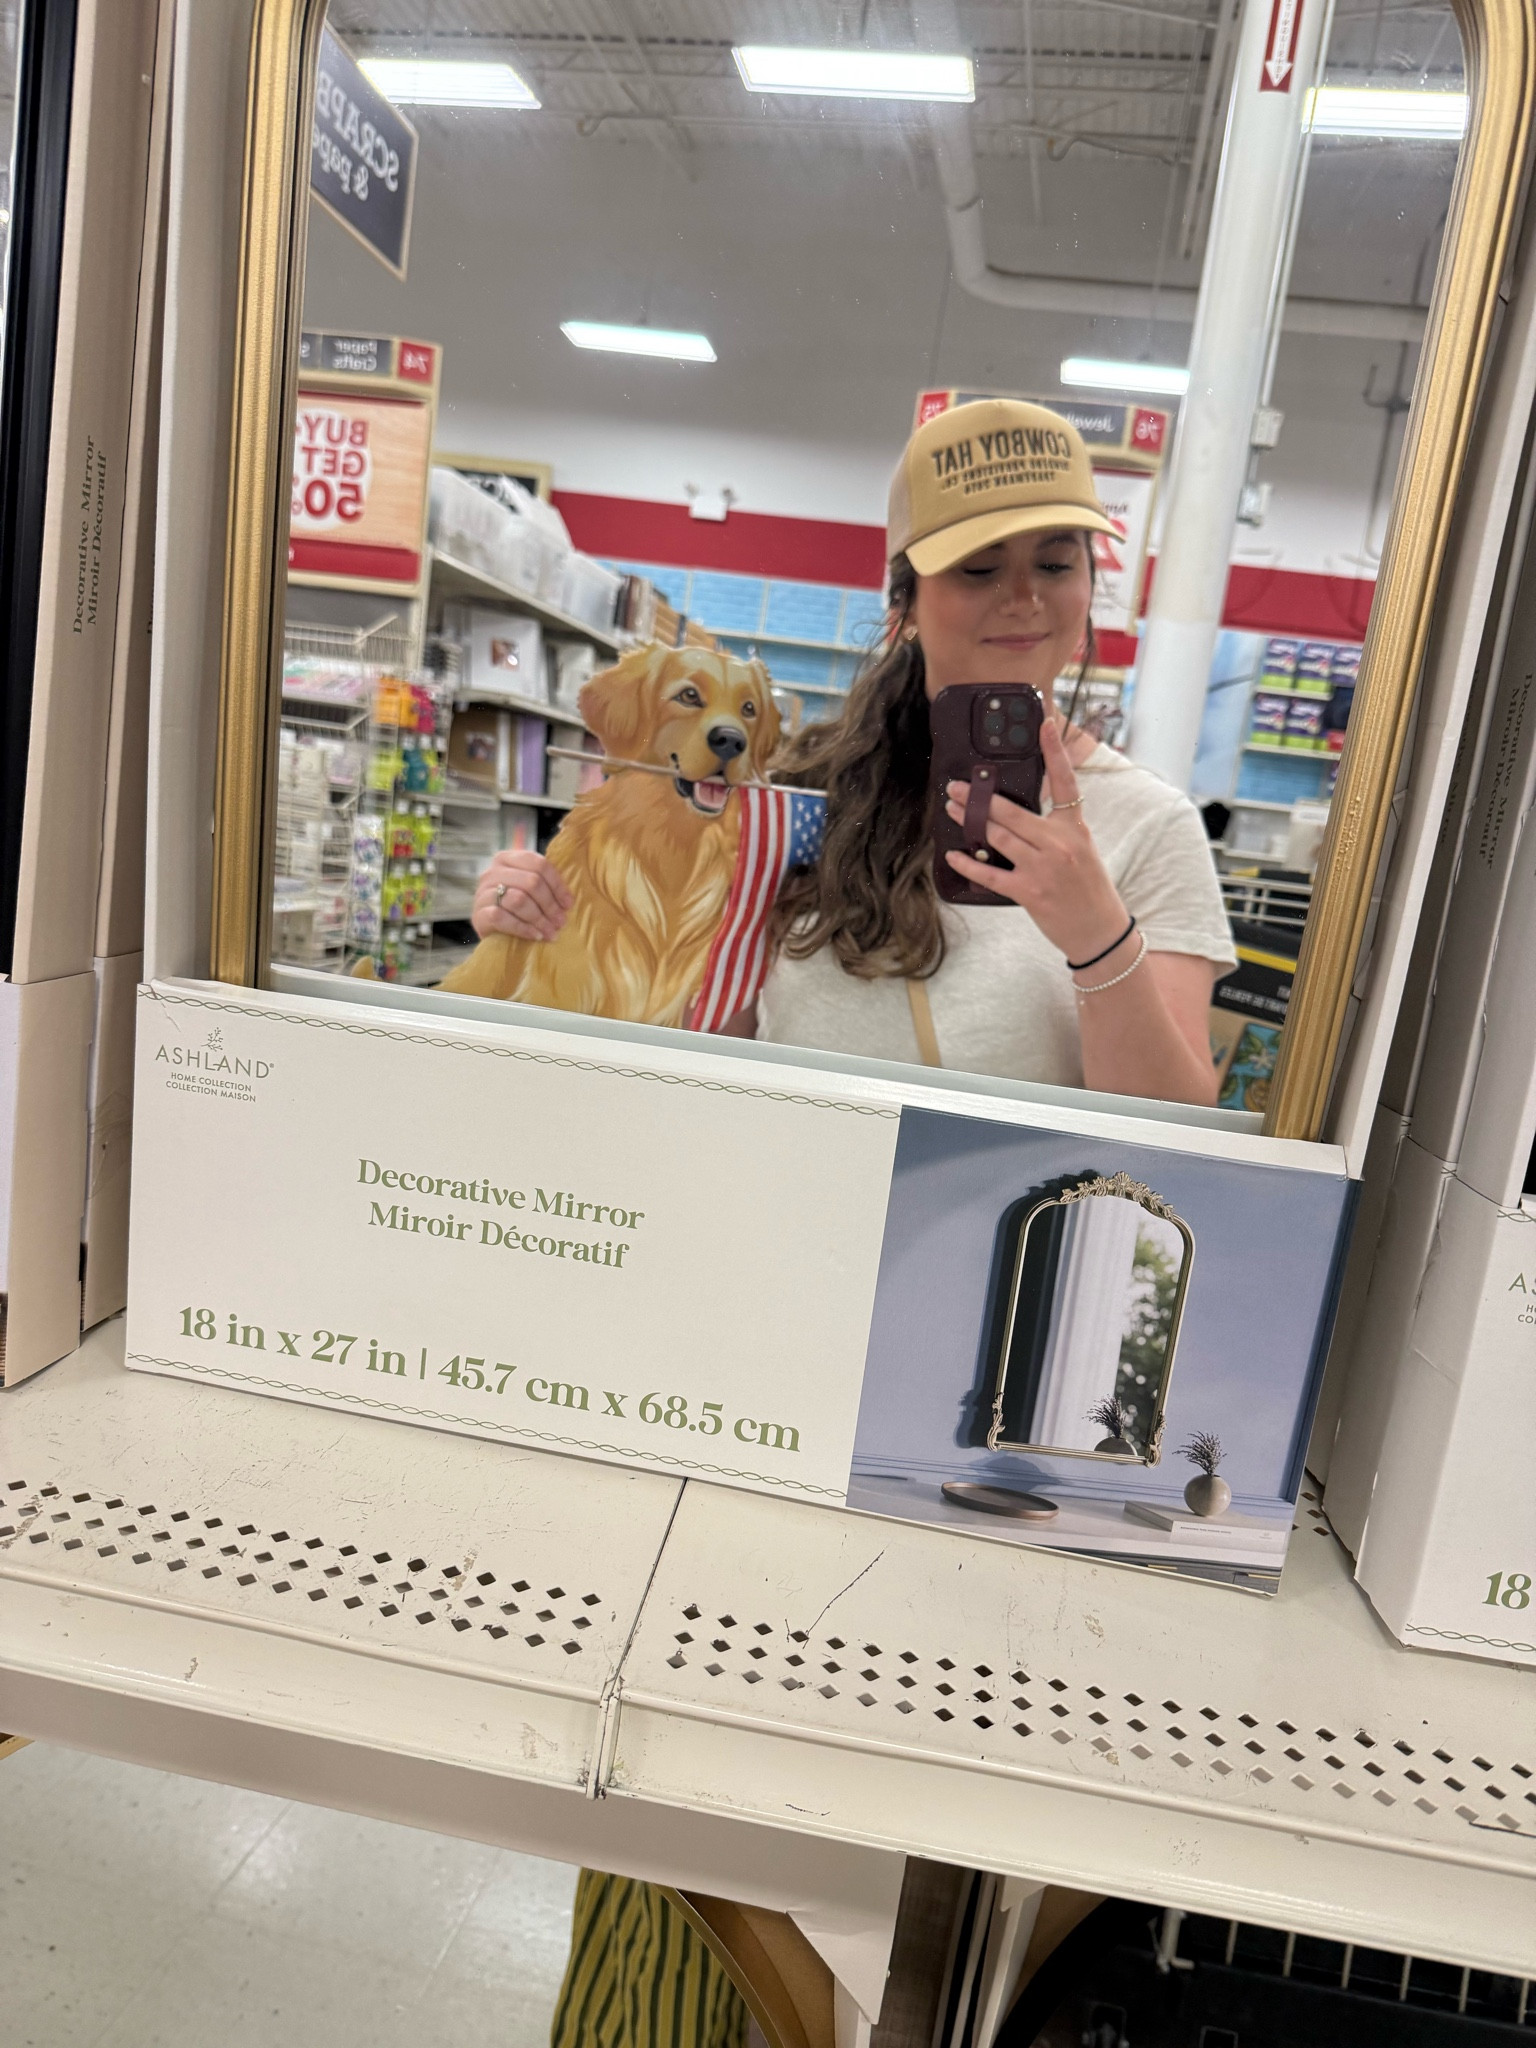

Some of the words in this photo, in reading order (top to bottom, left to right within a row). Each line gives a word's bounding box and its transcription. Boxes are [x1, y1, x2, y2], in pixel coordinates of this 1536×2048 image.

[72, 520, 90, 635] Decorative
[81, 434, 95, 512] Mirror
[92, 450, 107, 553] Décoratif
[87, 556, 101, 626] Miroir
[1500, 688, 1520, 757] Miroir
[1504, 673, 1533, 788] Decorative
[1487, 797, 1508, 870] Mirror
[165, 1080, 218, 1097] COLLECTION
[220, 1090, 256, 1103] MAISON
[170, 1071, 196, 1083] HOME
[198, 1076, 252, 1093] COLLECTION
[357, 1157, 526, 1211] Decorative
[532, 1188, 645, 1231] Mirror
[367, 1201, 473, 1243] Miroir
[479, 1219, 631, 1270] Décoratif
[178, 1306, 217, 1342] 18
[226, 1313, 267, 1351] in
[276, 1329, 302, 1357] x
[311, 1329, 358, 1367] 27
[365, 1337, 407, 1378] in
[437, 1352, 518, 1396] 45.7
[525, 1376, 590, 1413] cm
[600, 1392, 628, 1419] x
[637, 1390, 724, 1437] 68.5
[732, 1415, 801, 1453] cm
[1481, 1570, 1532, 1611] 18
